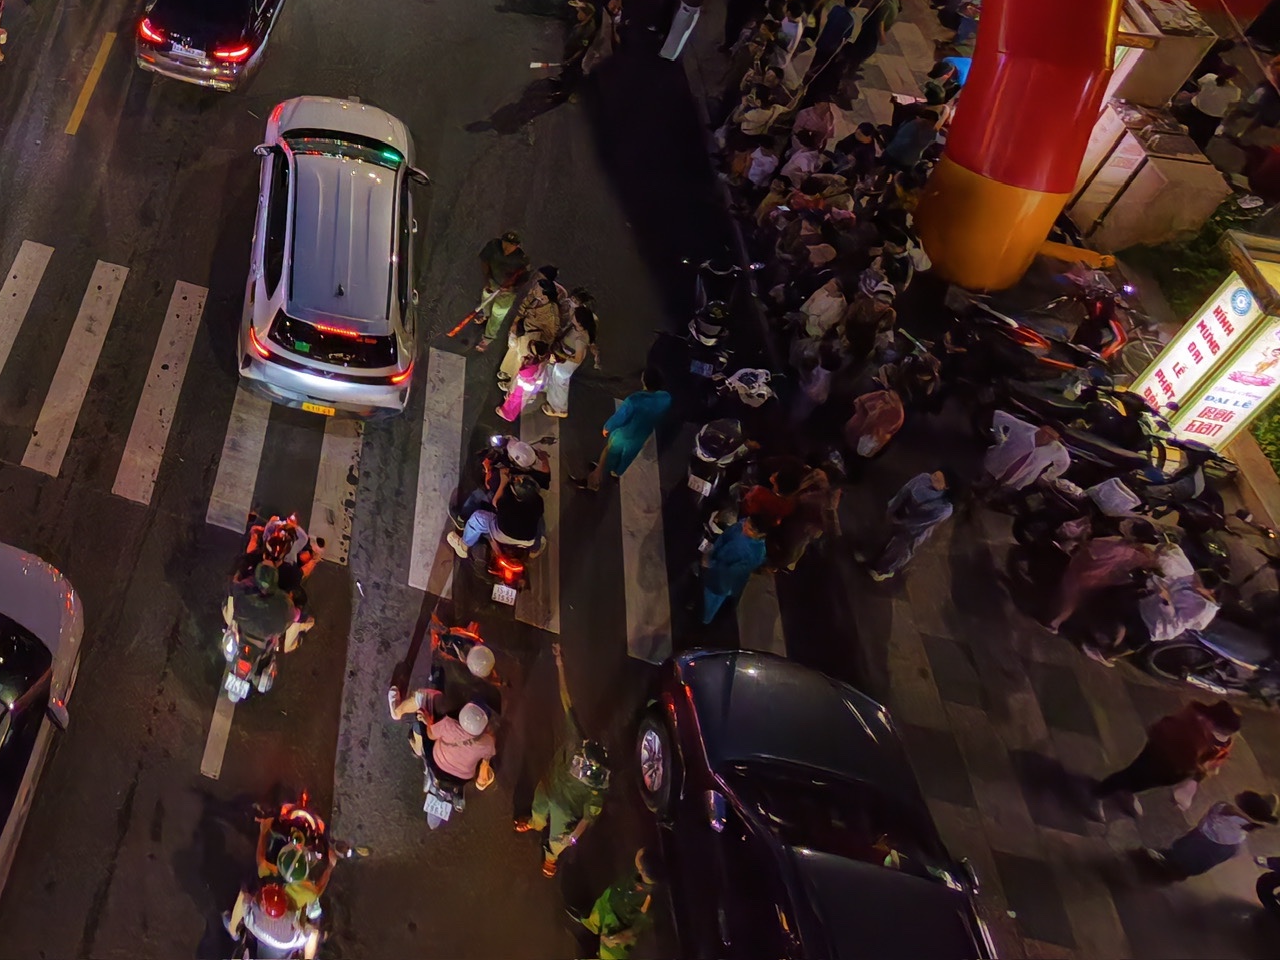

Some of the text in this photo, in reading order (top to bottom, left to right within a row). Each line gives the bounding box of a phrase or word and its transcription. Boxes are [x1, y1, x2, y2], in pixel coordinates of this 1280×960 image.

[1196, 319, 1221, 356] MỪNG
[1154, 368, 1176, 401] PHẬT
[1172, 362, 1189, 379] LỄ
